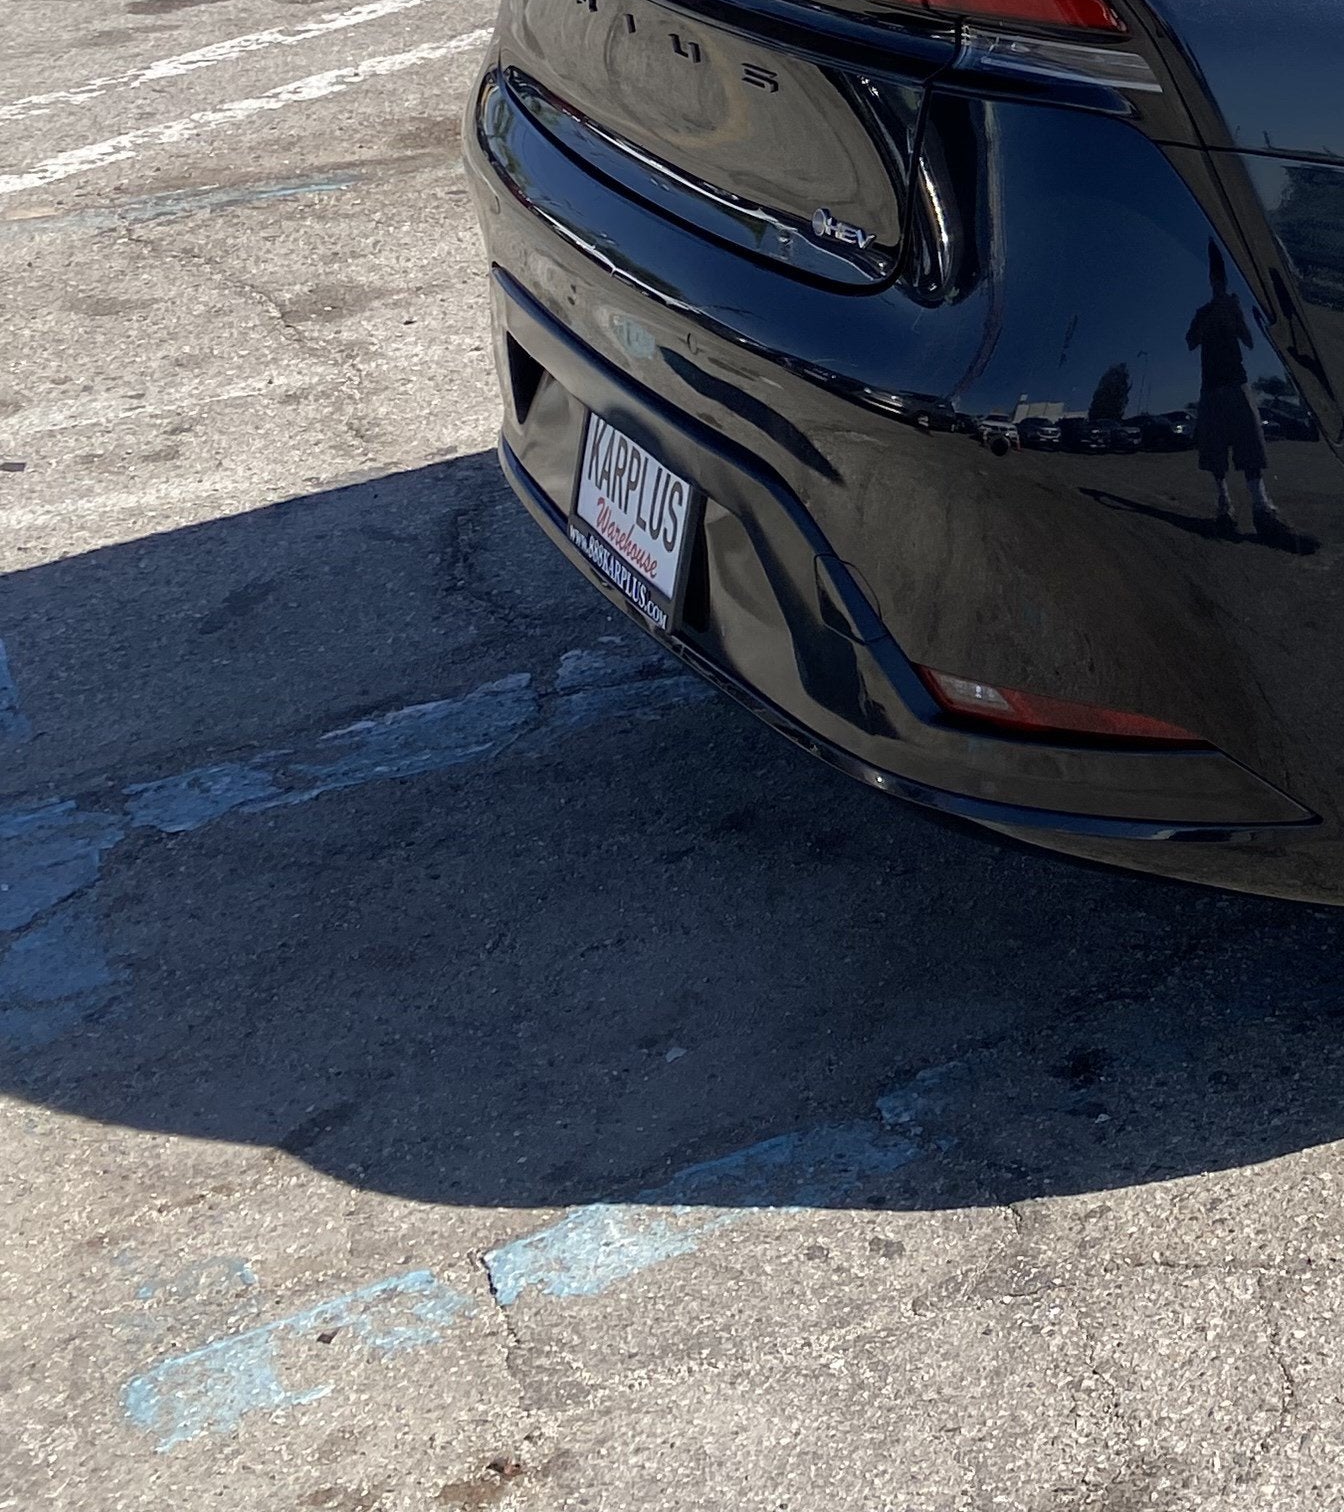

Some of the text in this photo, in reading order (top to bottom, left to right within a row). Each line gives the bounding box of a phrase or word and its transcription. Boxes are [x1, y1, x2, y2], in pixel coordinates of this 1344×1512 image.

[825, 217, 876, 249] HEV
[588, 419, 683, 552] KARPLUS
[596, 497, 658, 579] Warehouse
